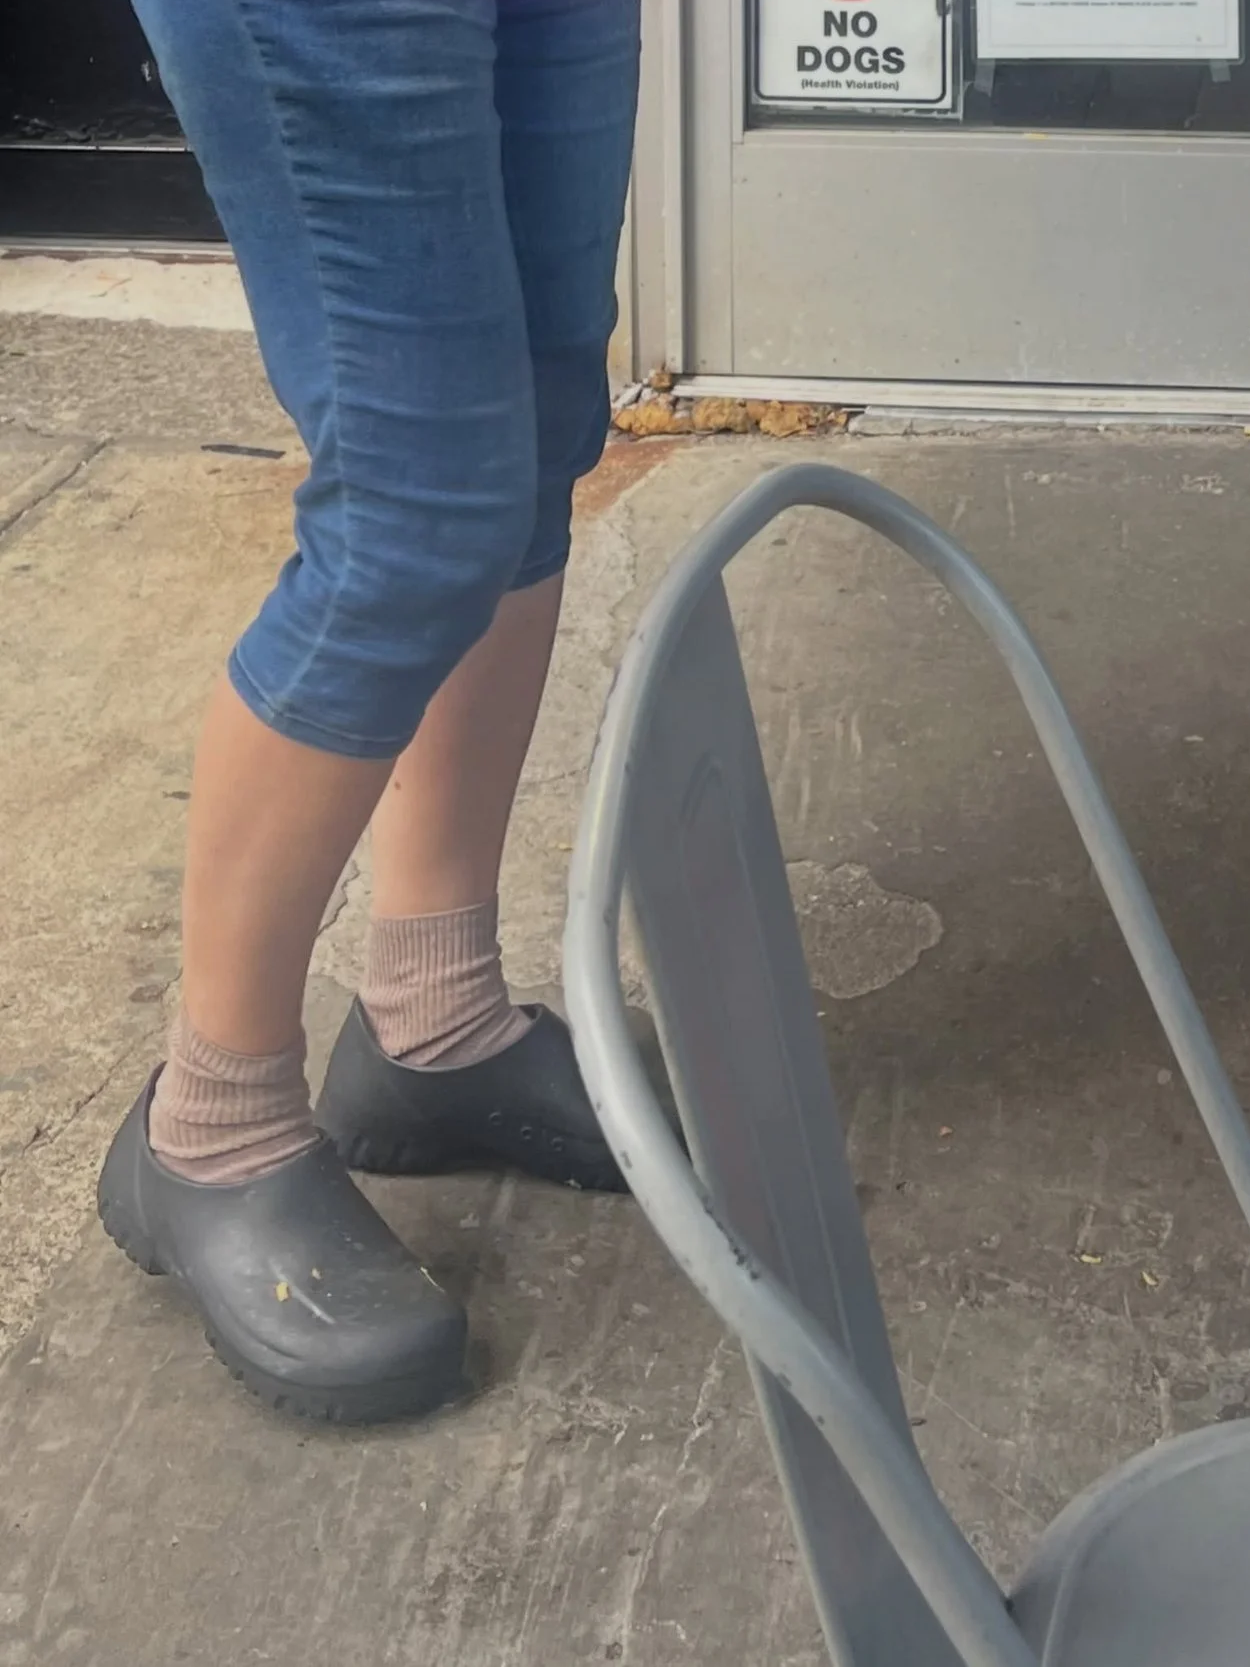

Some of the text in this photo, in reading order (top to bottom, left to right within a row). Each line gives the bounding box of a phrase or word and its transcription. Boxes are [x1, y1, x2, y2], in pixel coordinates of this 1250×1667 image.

[823, 9, 878, 38] NO
[796, 45, 906, 75] DOGS
[800, 78, 900, 92] (Health Violation)
